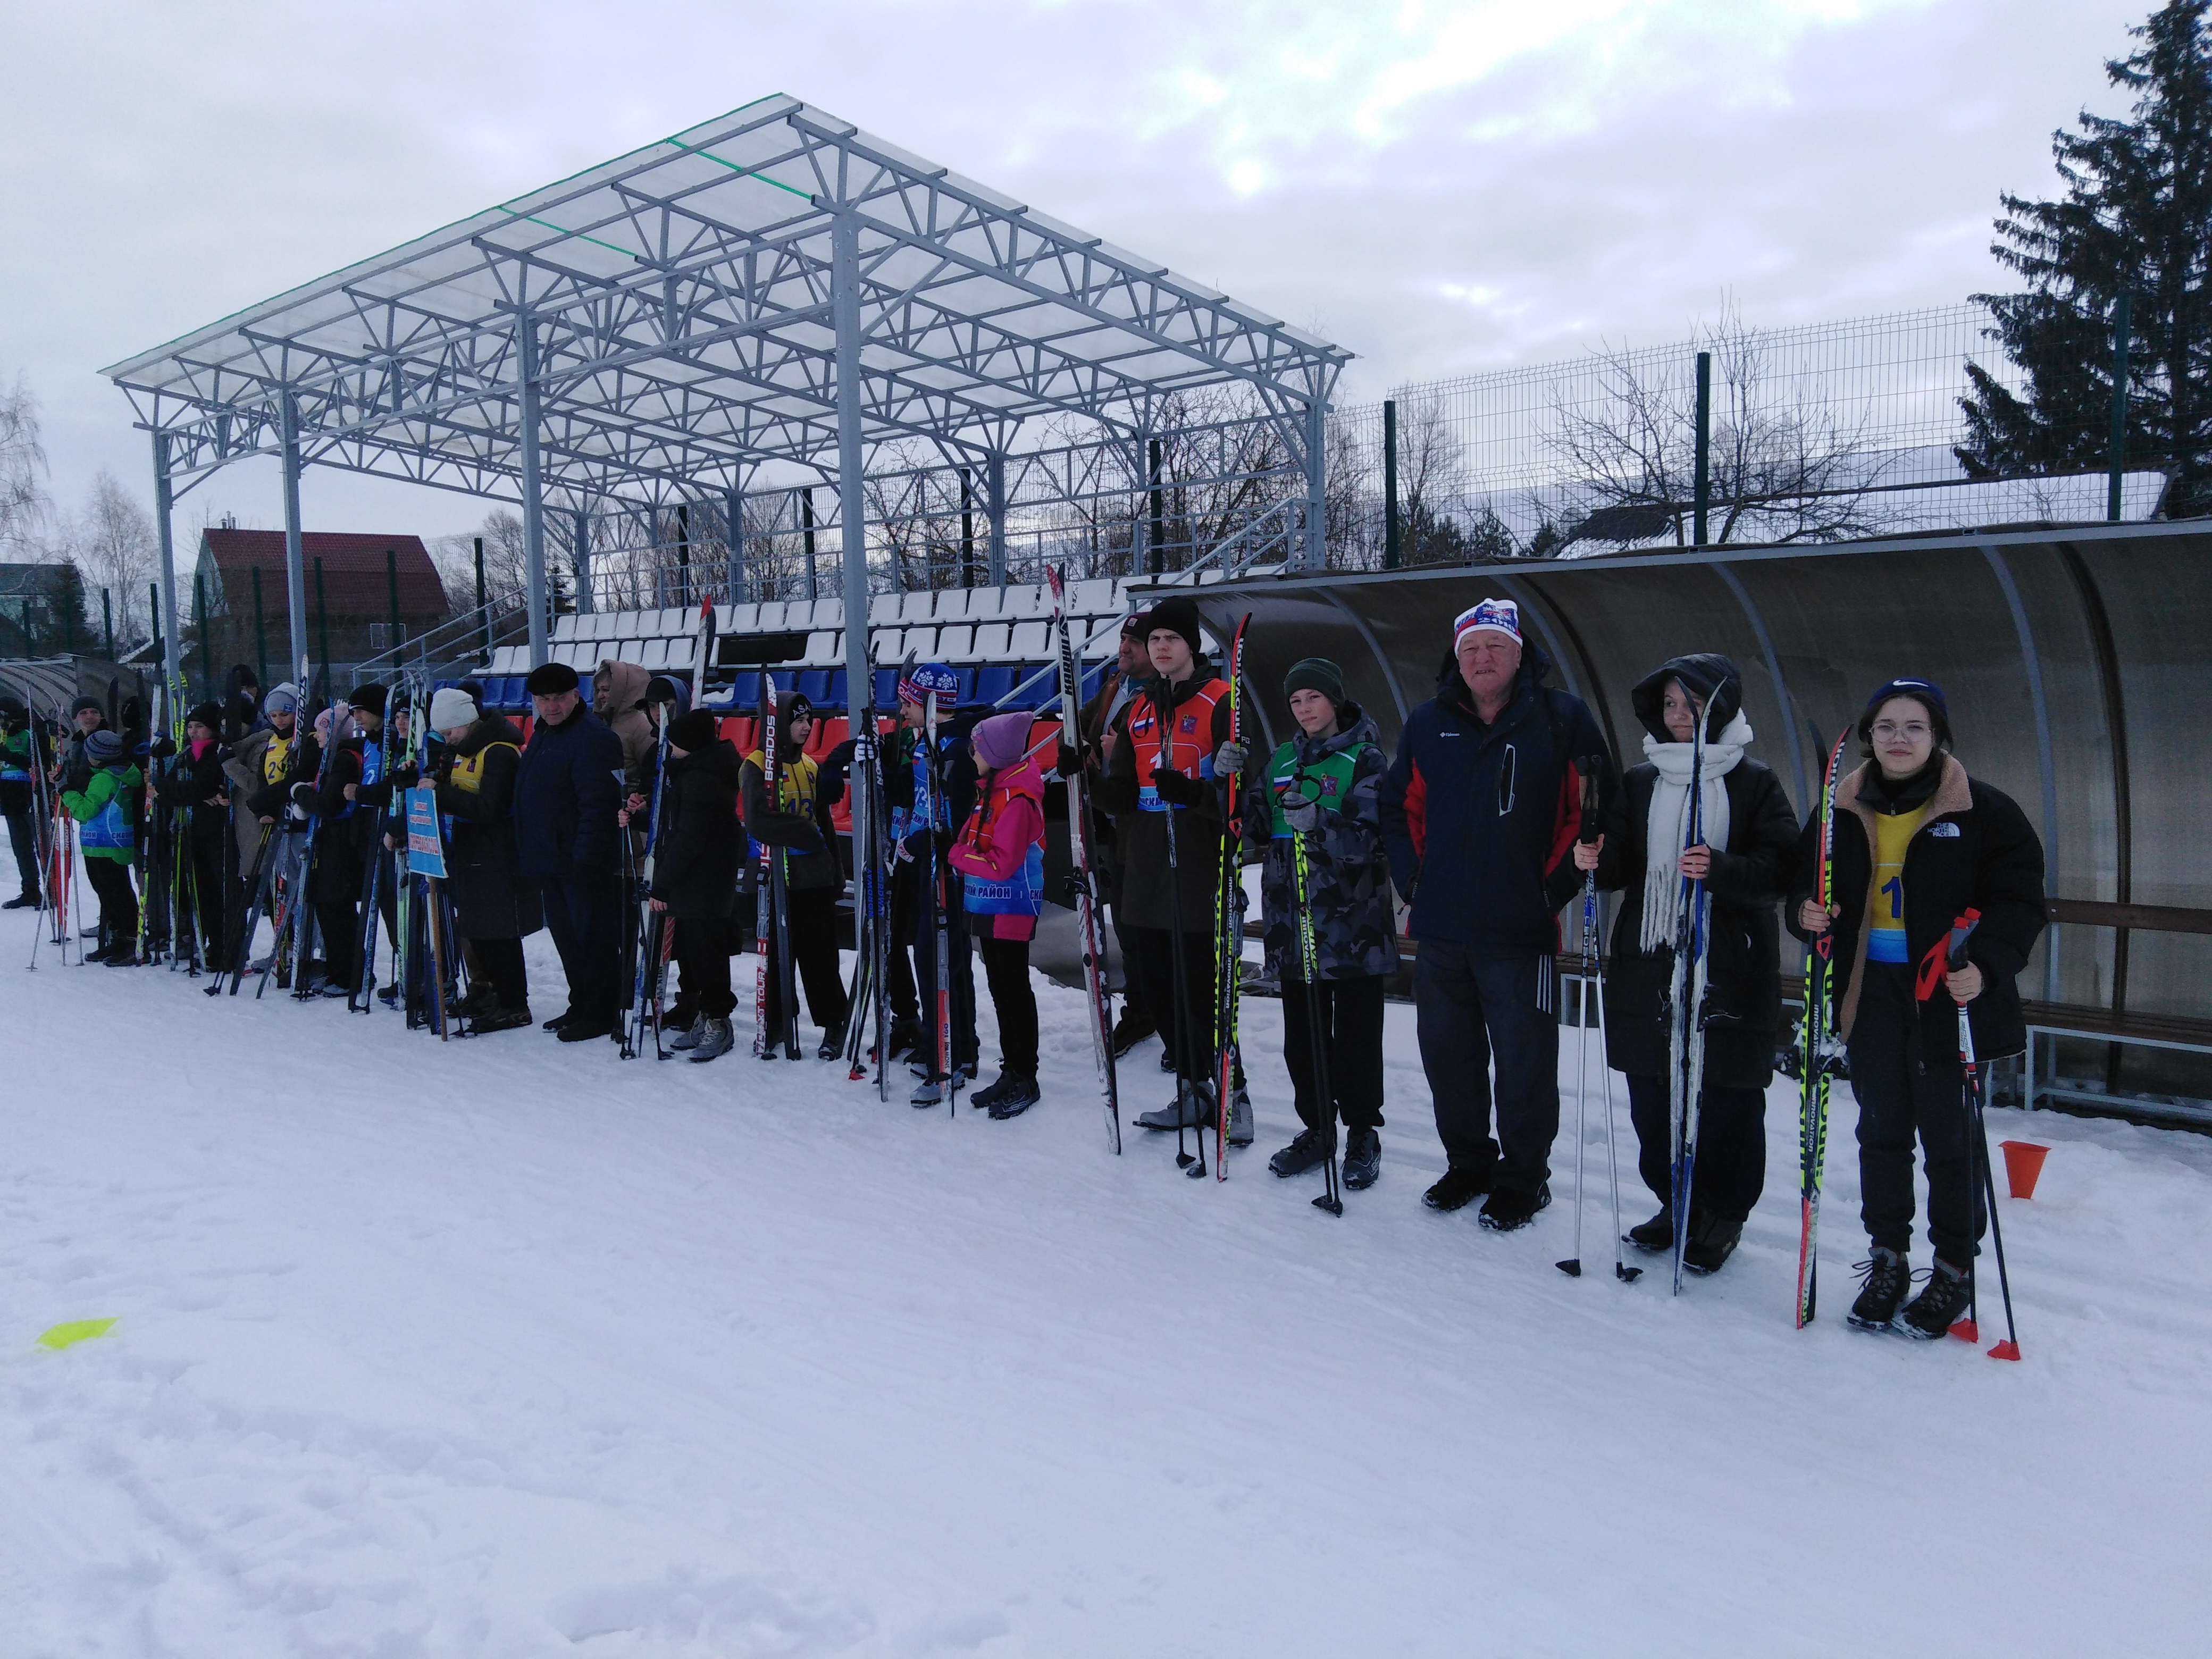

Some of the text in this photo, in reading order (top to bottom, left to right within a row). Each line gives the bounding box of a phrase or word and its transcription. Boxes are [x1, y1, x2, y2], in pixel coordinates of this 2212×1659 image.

[1061, 639, 1073, 696] KARHU
[764, 715, 776, 781] BRADOS
[268, 761, 276, 780] 2
[787, 798, 813, 821] 13
[978, 884, 1011, 898] РАЙОН
[1881, 876, 1901, 918] 1
[757, 970, 768, 1003] TOUR
